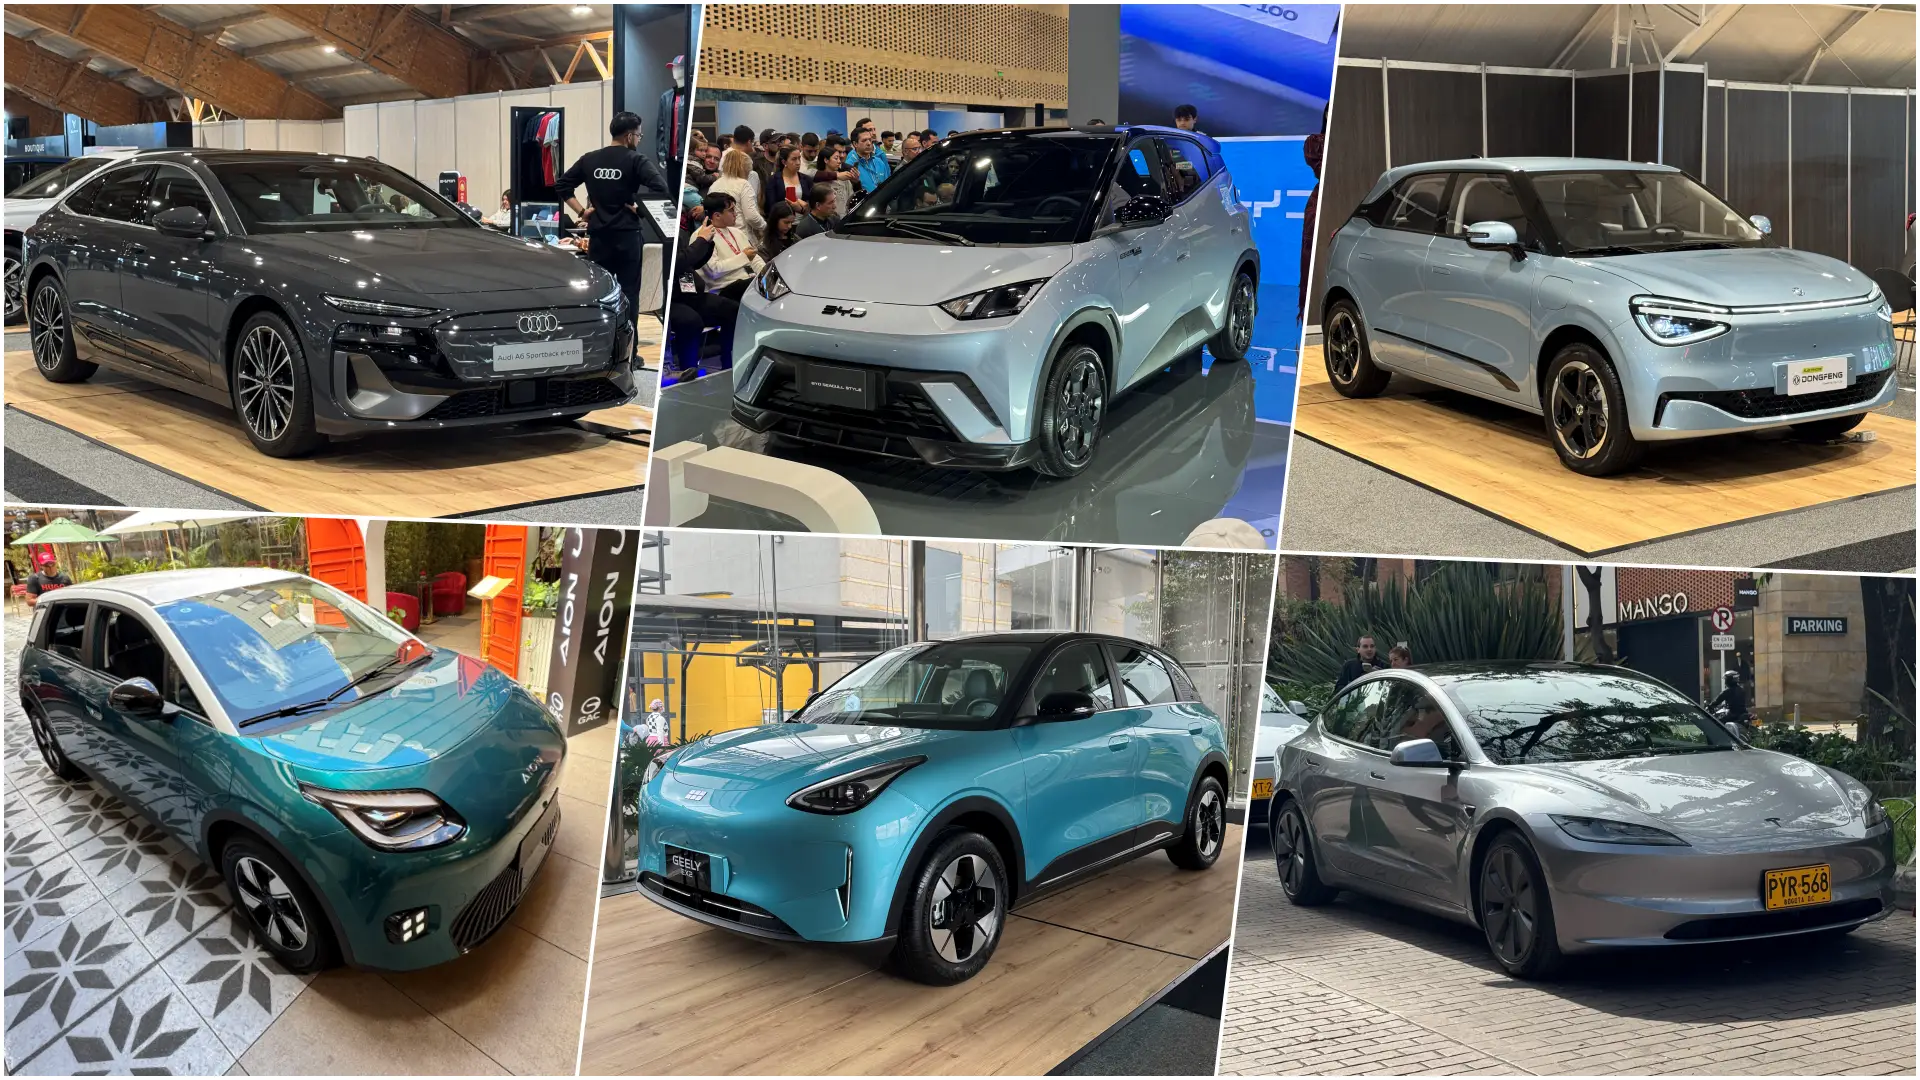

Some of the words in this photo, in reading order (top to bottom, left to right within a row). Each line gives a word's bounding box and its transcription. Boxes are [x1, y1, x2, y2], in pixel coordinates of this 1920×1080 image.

[24, 144, 45, 152] BOUTIQUE
[821, 304, 867, 318] BYD
[515, 352, 525, 360] A6
[526, 351, 559, 361] Sportback
[1801, 371, 1843, 383] DONGFENG
[1620, 592, 1688, 622] MANGO
[559, 573, 579, 667] AION
[593, 571, 620, 666] AION
[1793, 620, 1843, 632] PARKING
[549, 704, 564, 723] GAC
[577, 711, 601, 725] GAC
[521, 755, 543, 785] AION
[672, 855, 702, 872] GEELY
[680, 868, 693, 878] EX2
